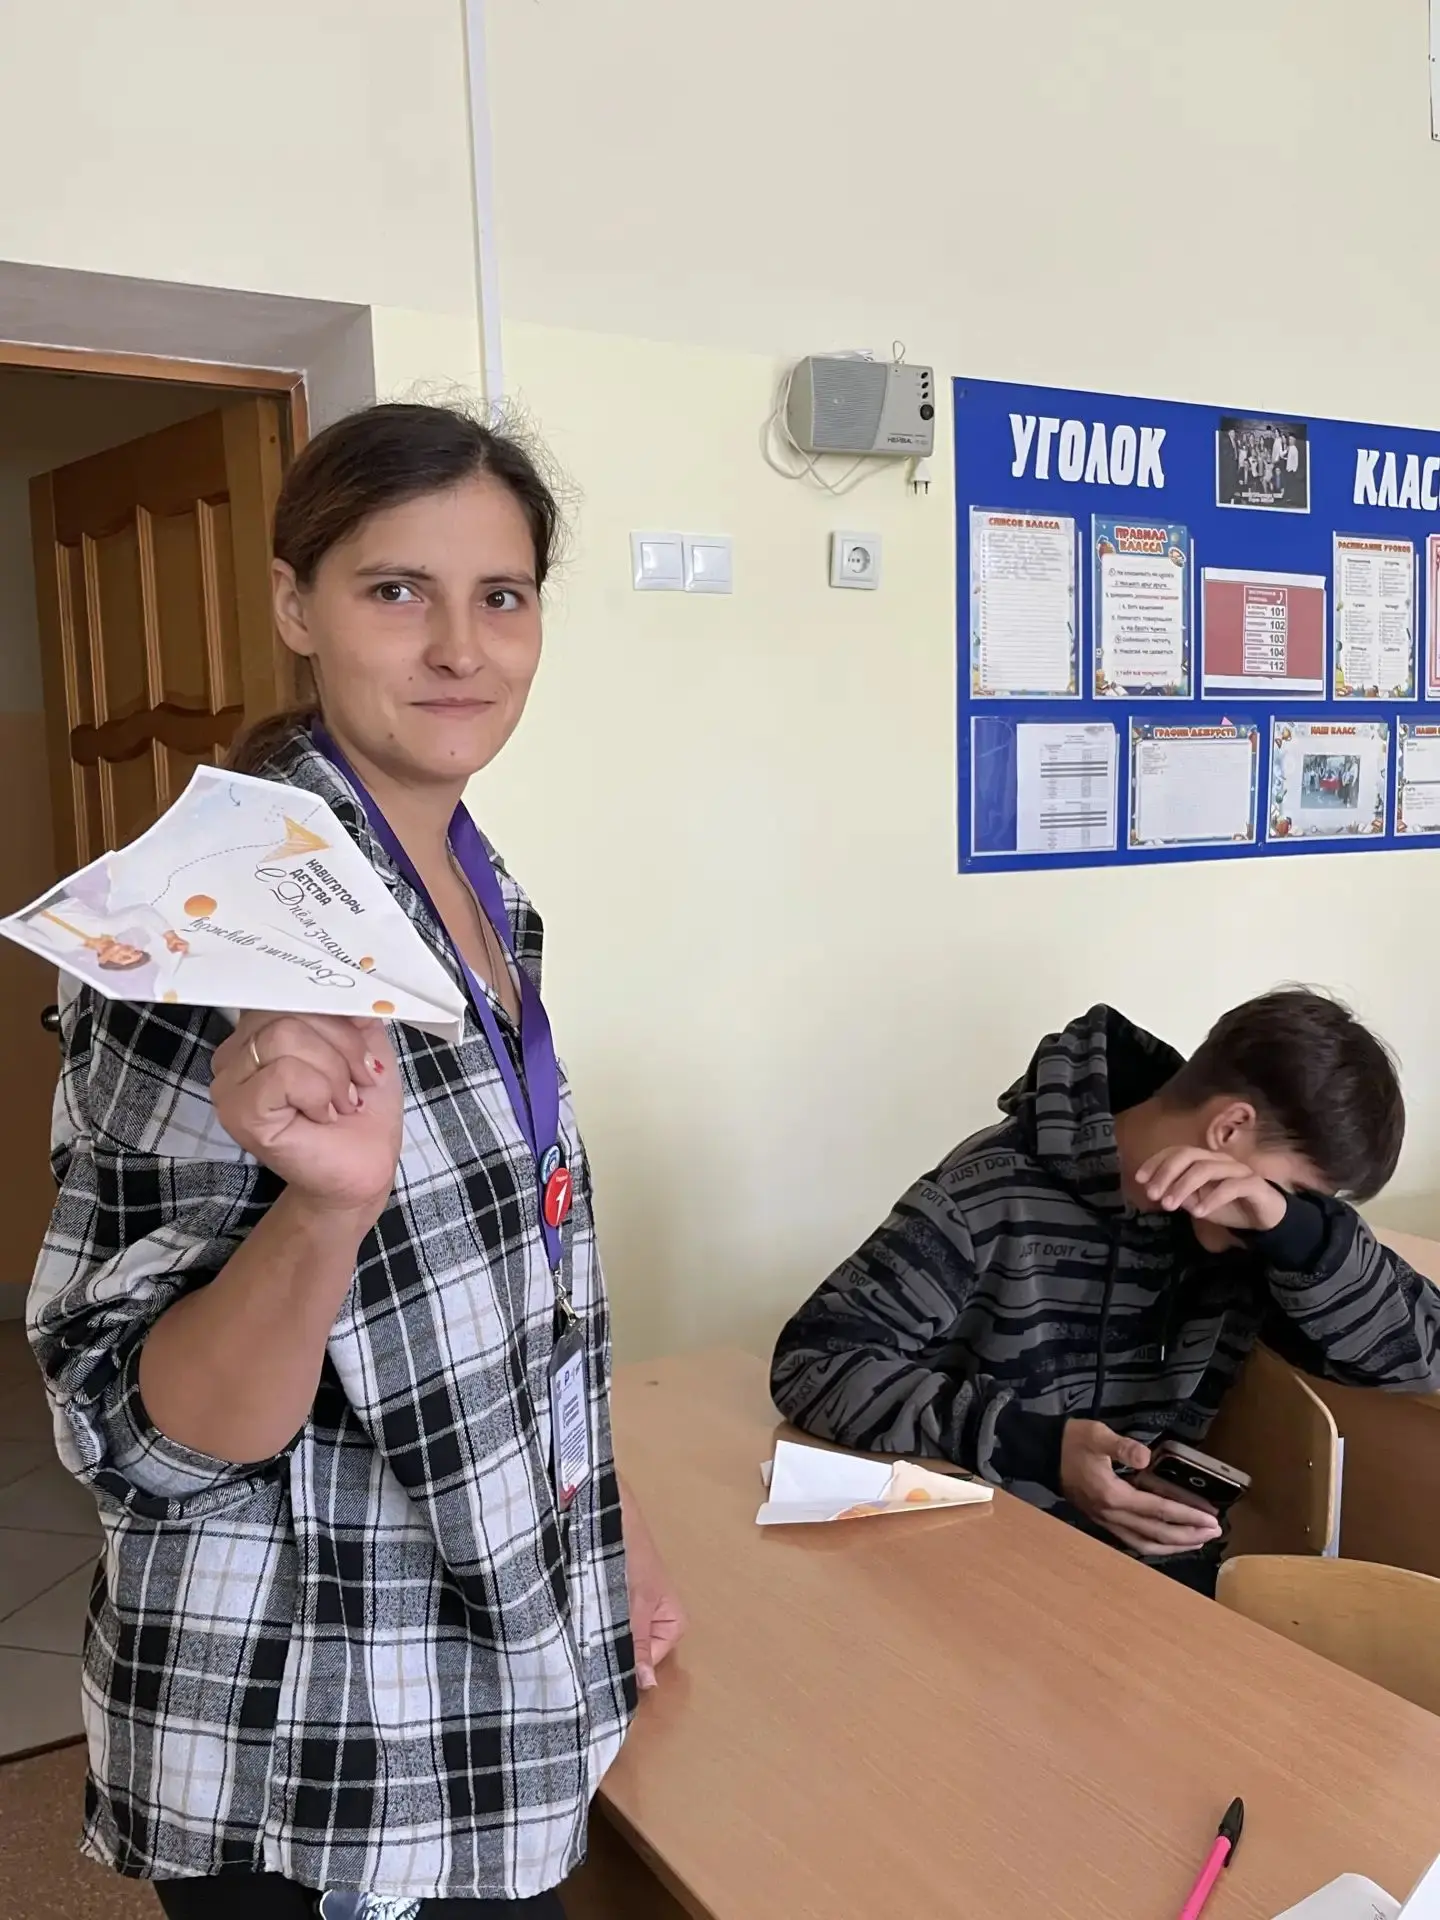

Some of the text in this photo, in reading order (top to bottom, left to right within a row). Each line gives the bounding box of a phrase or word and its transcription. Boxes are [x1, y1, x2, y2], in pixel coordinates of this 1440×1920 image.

[1009, 413, 1167, 488] УГОЛОК
[988, 517, 1061, 530] СПИСОК КЛАССА
[1114, 526, 1168, 542] ПРАВИЛА
[1119, 539, 1164, 554] КЛАССА
[1270, 607, 1285, 617] 101
[1270, 620, 1286, 630] 102
[1269, 634, 1285, 644] 103
[1269, 647, 1285, 657] 104
[1269, 661, 1285, 671] 112
[1310, 726, 1356, 735] НАШ КЛАСС
[289, 868, 333, 906] ДЕТСТВА
[305, 858, 365, 915] НАВИГАТОРЫ
[269, 881, 317, 928] Днём
[180, 916, 355, 988] Берегите дружбу
[950, 1163, 981, 1184] JUST
